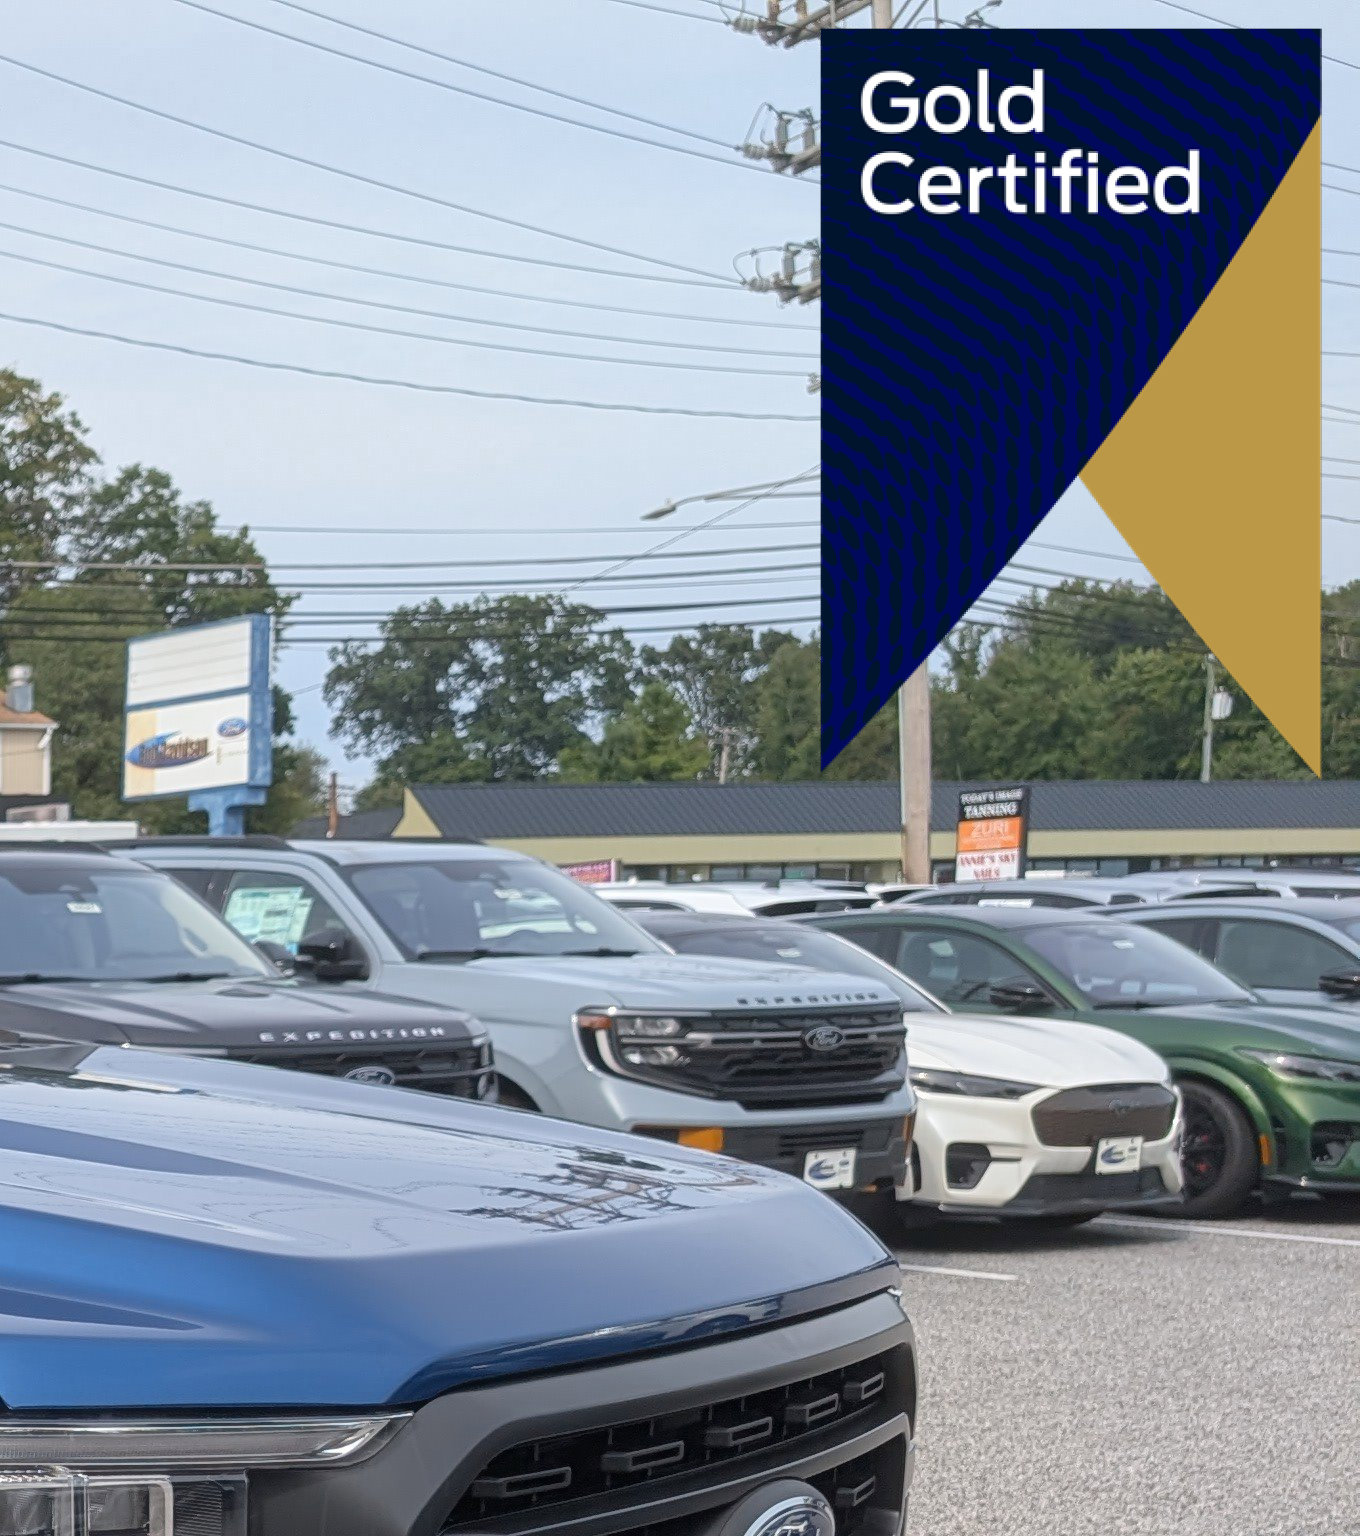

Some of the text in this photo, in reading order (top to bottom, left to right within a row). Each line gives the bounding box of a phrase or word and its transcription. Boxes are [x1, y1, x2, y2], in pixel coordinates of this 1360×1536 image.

[964, 801, 1018, 819] TANNING
[736, 992, 879, 1005] EXPEDITION
[259, 1025, 445, 1043] EXPEDITION
